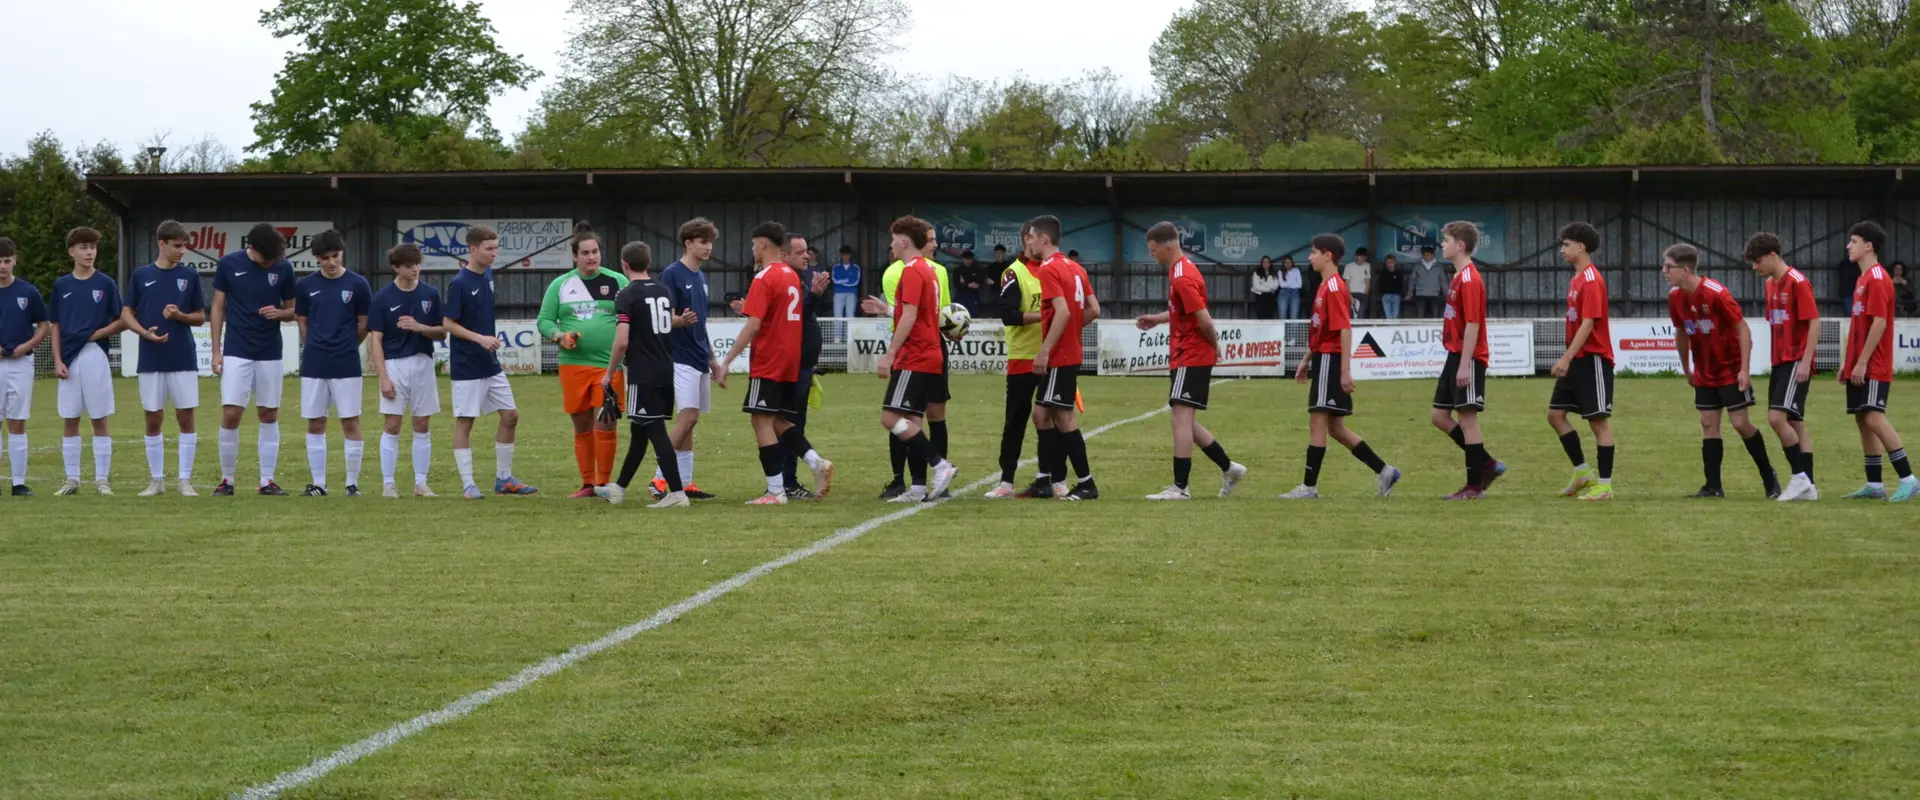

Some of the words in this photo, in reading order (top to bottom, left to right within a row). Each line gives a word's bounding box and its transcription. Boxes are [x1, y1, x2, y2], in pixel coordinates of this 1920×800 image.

[497, 221, 567, 234] FABRICANT
[187, 225, 227, 258] olly
[420, 244, 469, 256] design
[498, 236, 523, 250] ALU
[1074, 274, 1085, 310] 4
[786, 285, 801, 321] 2
[645, 296, 672, 335] 16
[494, 330, 534, 348] AC
[1138, 332, 1170, 348] Faite
[1216, 328, 1242, 341] nce
[1391, 329, 1443, 345] ALUR
[853, 339, 888, 355] WA
[1102, 357, 1127, 370] aux
[1129, 352, 1170, 373] parten
[1360, 361, 1402, 371] Fabrication
